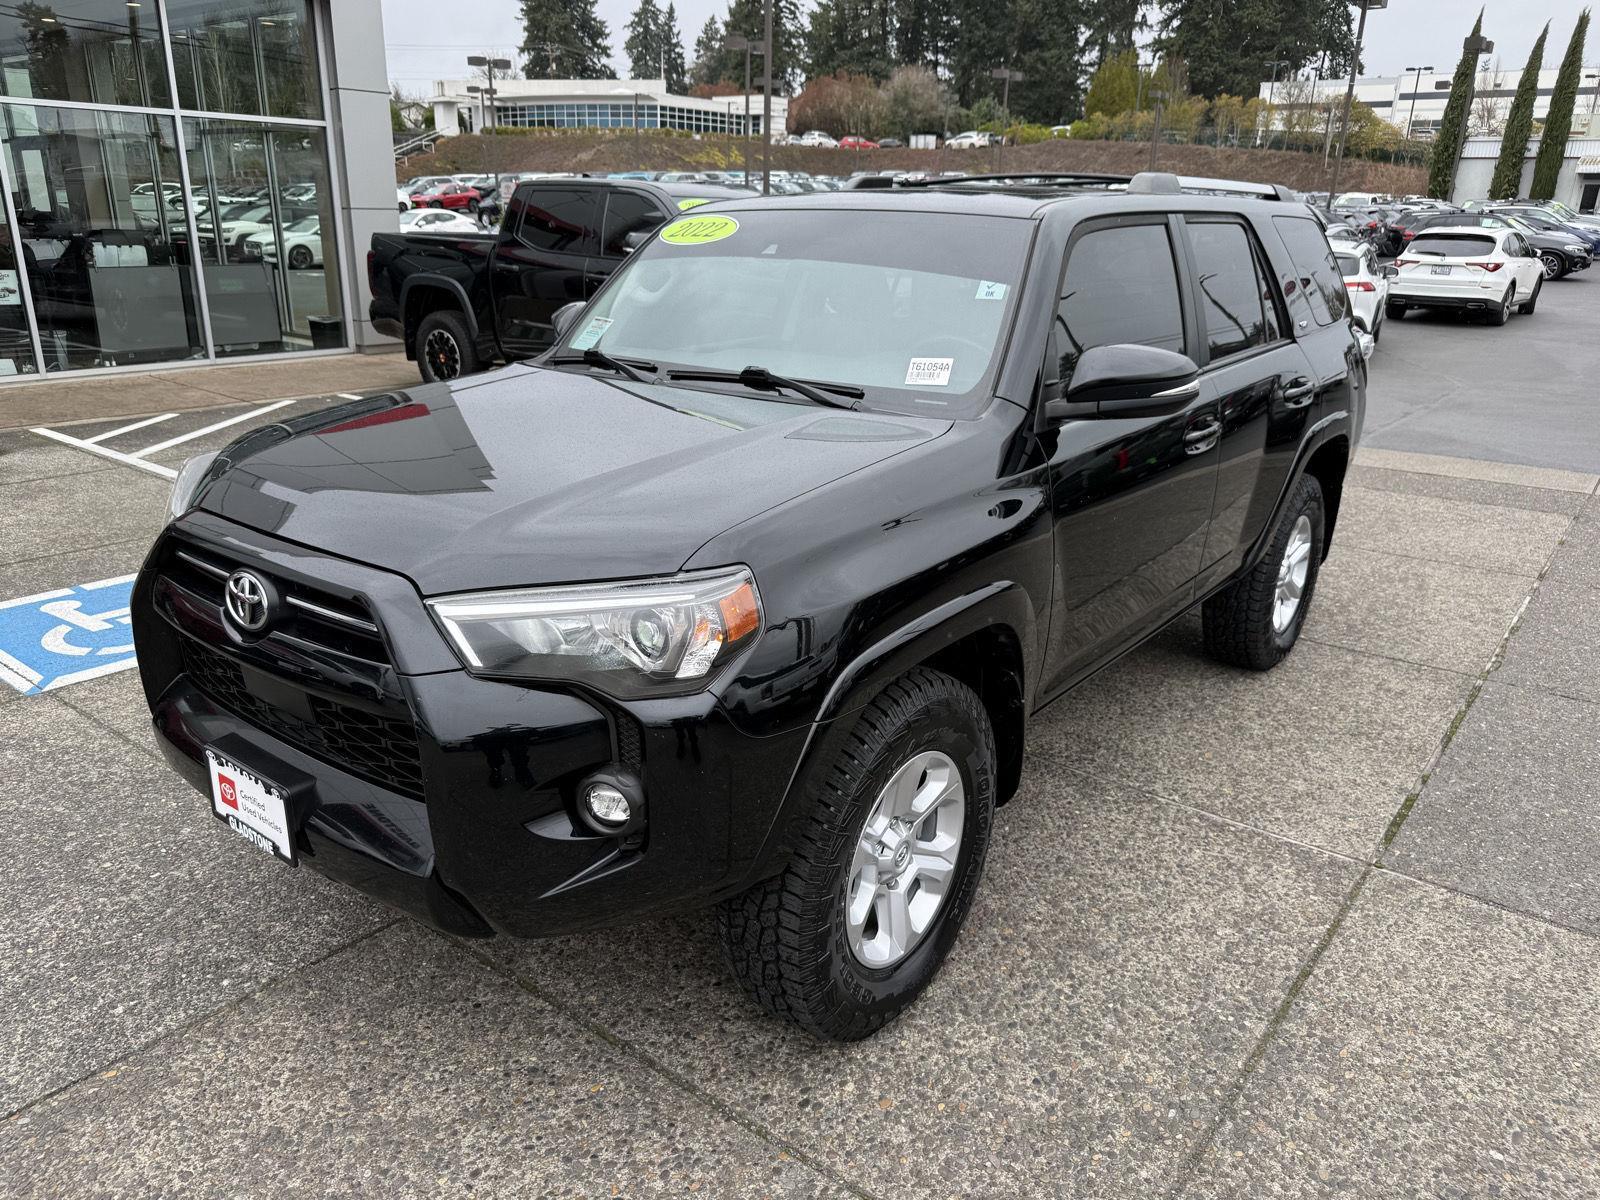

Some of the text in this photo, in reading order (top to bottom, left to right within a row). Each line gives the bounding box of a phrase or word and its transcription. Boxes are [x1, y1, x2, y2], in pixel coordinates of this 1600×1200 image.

[668, 221, 728, 238] 2022
[911, 361, 950, 372] T61054A
[239, 789, 266, 812] Certified
[241, 802, 283, 834] Used Vehicles
[228, 814, 275, 856] GLADSTONE
